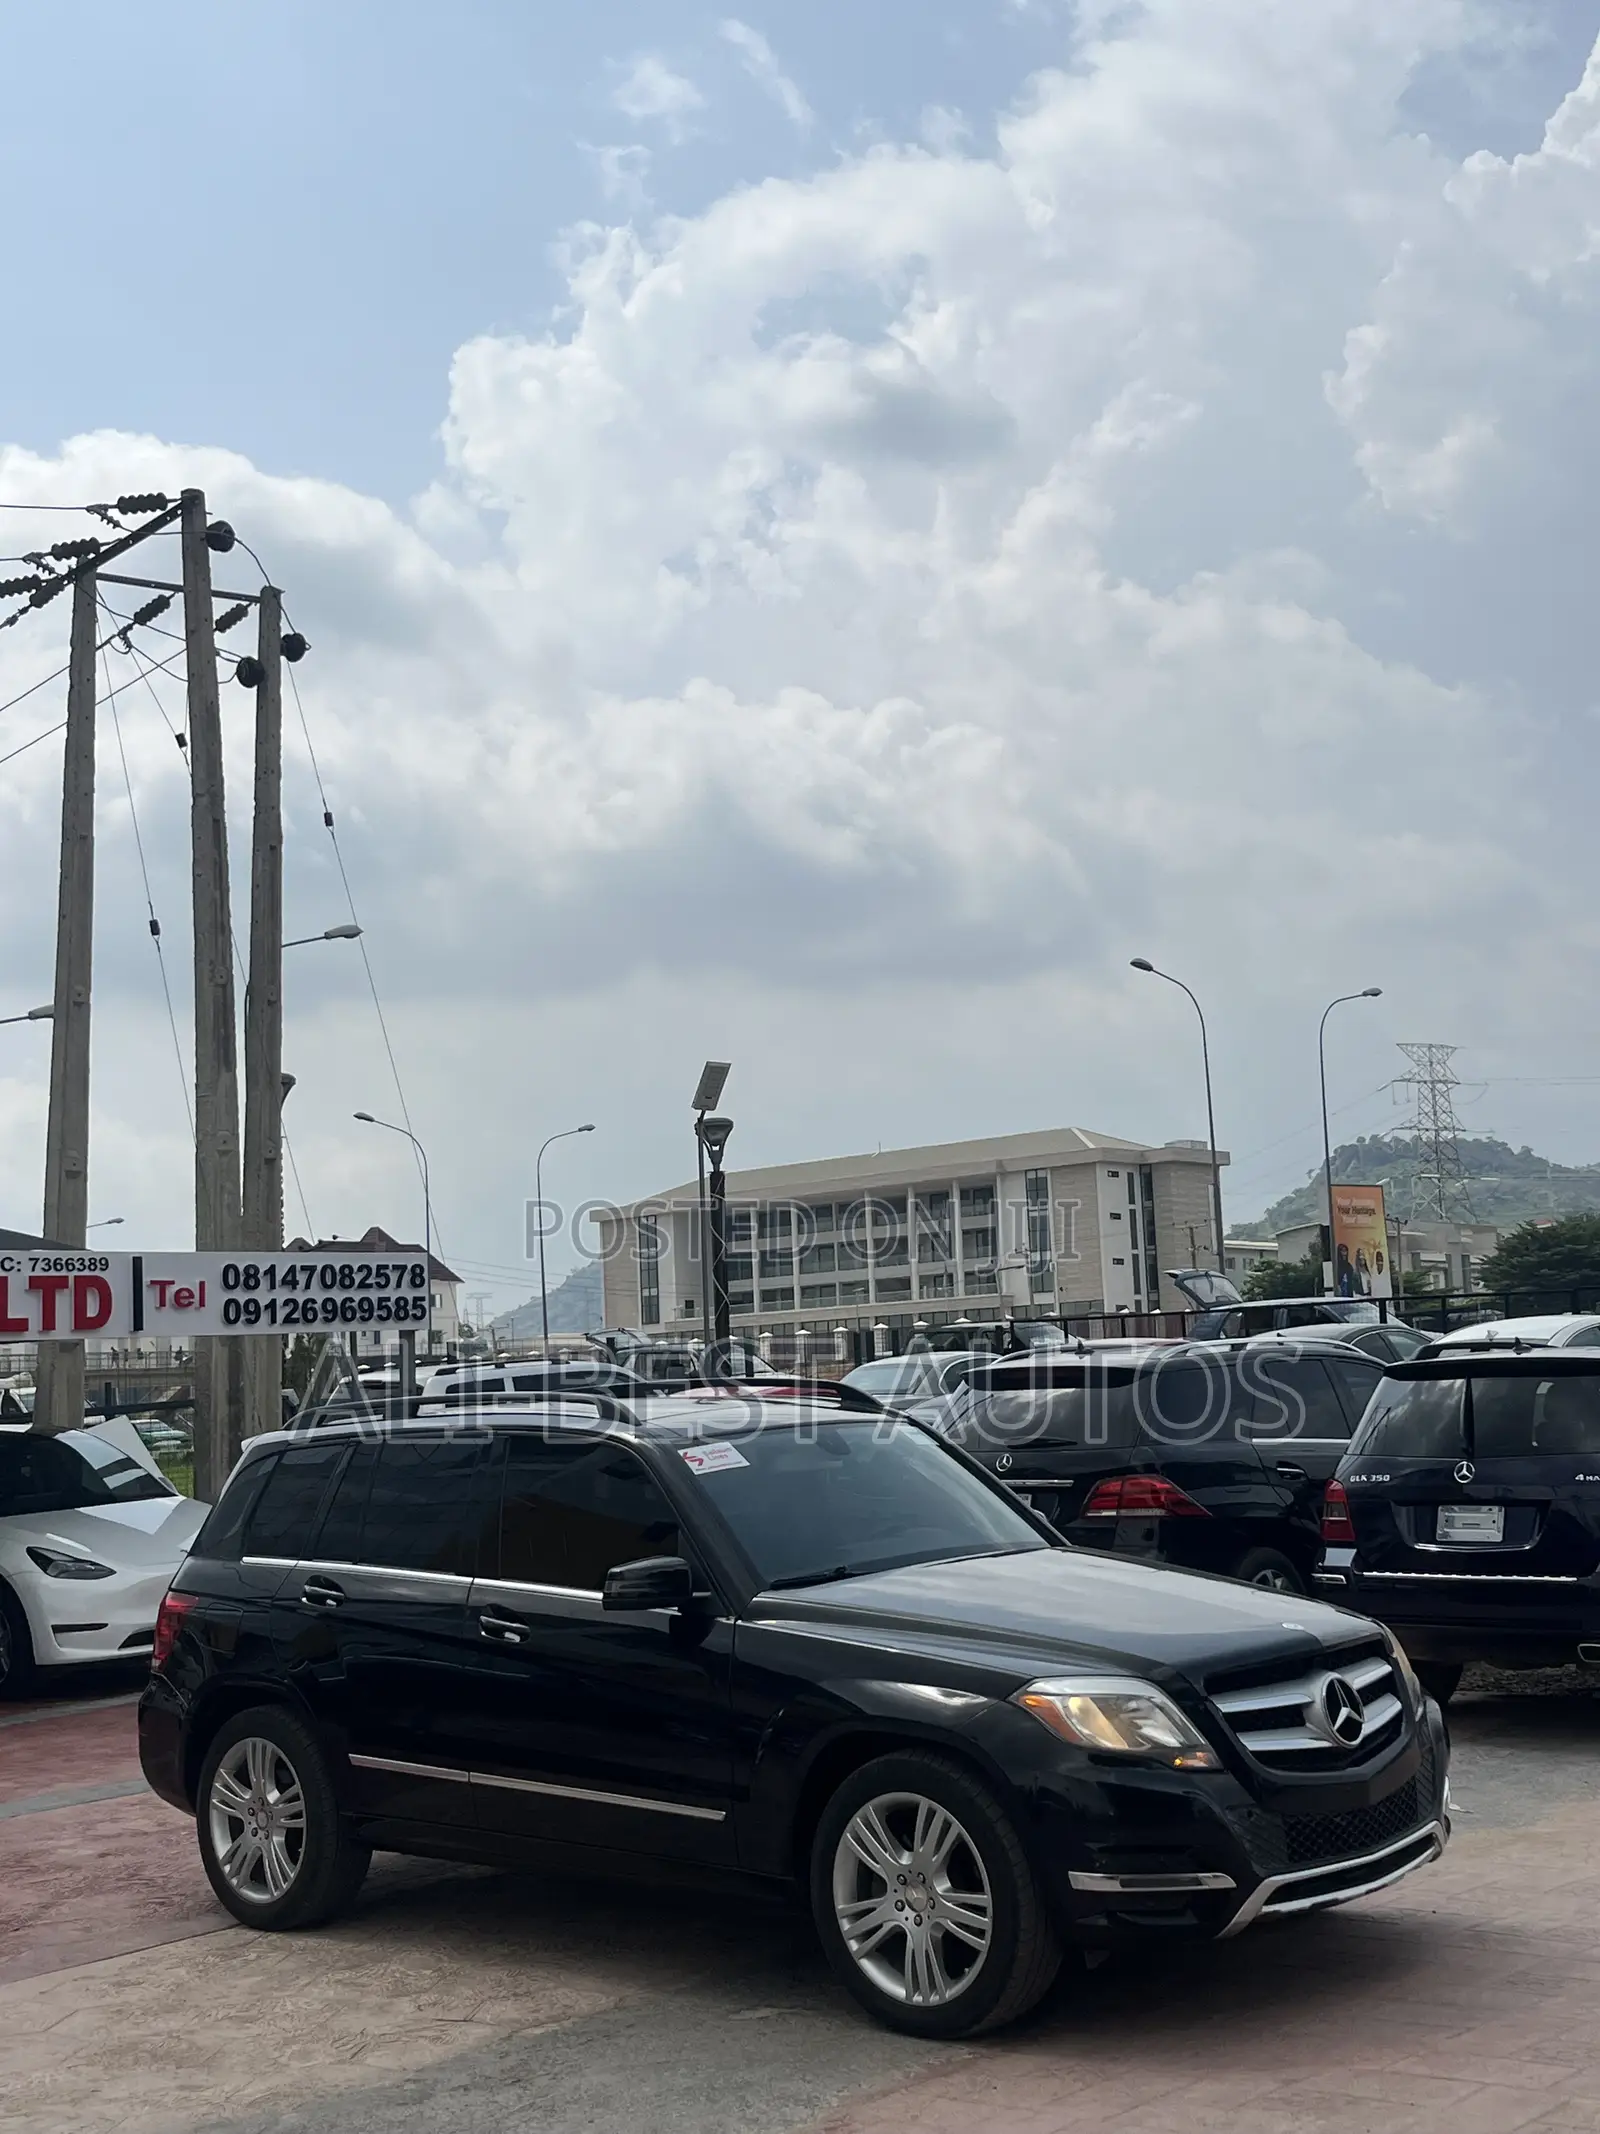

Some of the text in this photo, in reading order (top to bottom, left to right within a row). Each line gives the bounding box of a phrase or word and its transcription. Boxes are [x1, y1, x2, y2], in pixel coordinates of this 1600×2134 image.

[28, 1256, 110, 1273] 7366389
[221, 1263, 426, 1291] 08147082578
[0, 1274, 113, 1333] LTD
[149, 1279, 206, 1308] Tel
[223, 1296, 427, 1325] 09126969585
[1370, 1474, 1390, 1482] 350
